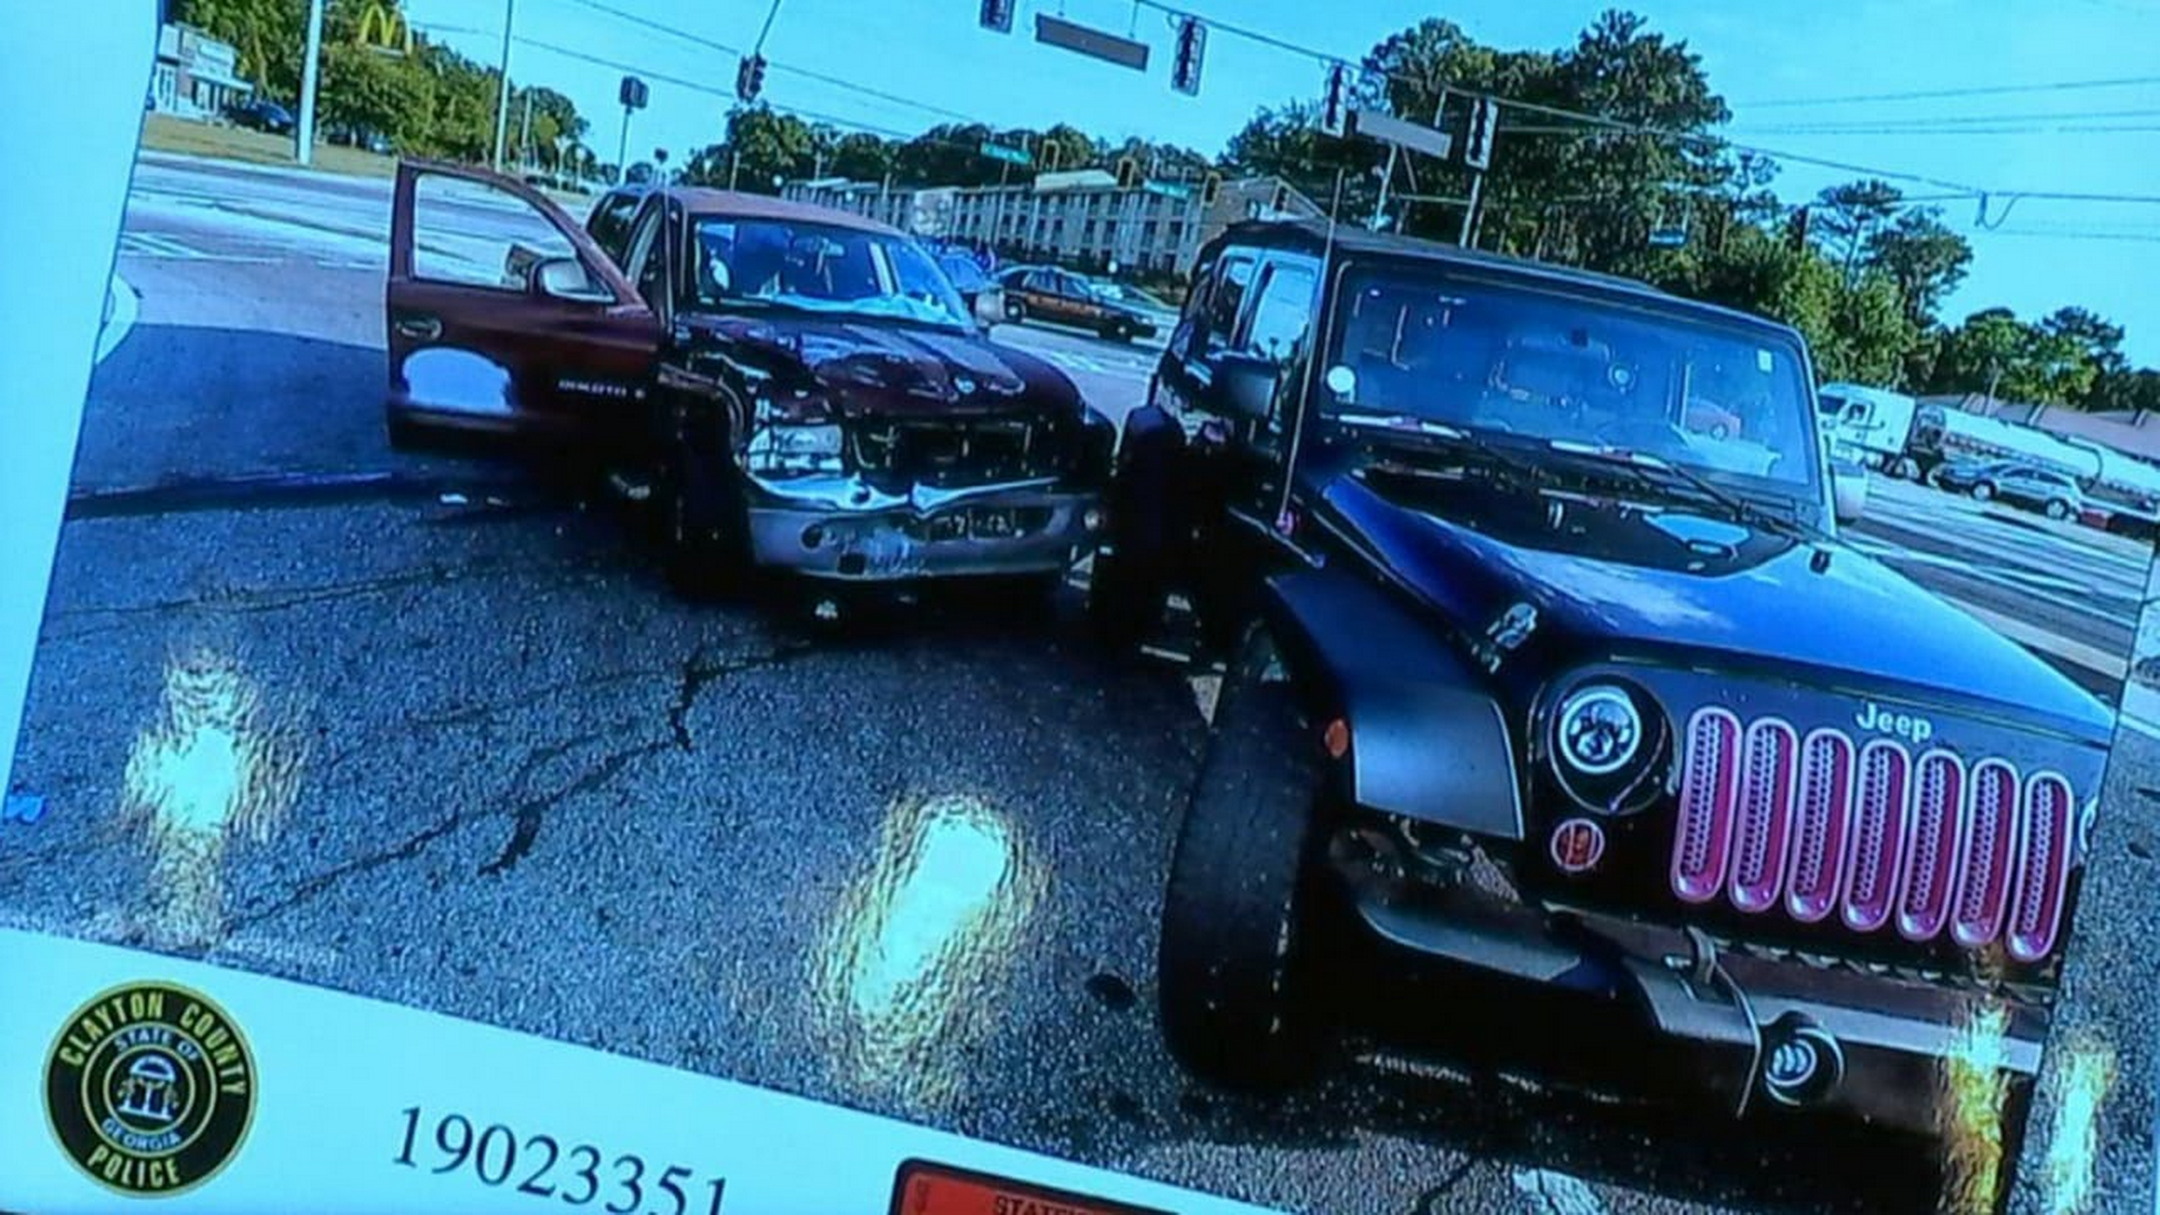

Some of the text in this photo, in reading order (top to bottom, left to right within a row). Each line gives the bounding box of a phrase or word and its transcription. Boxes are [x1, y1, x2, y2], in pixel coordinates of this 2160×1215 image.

[1855, 703, 1932, 743] Jeep
[60, 992, 247, 1097] CLAYTON COUNTY
[114, 1028, 202, 1062] STATE OF
[102, 1118, 183, 1152] GEORGIA
[87, 1144, 181, 1188] POLICE
[393, 1105, 727, 1215] 19023351
